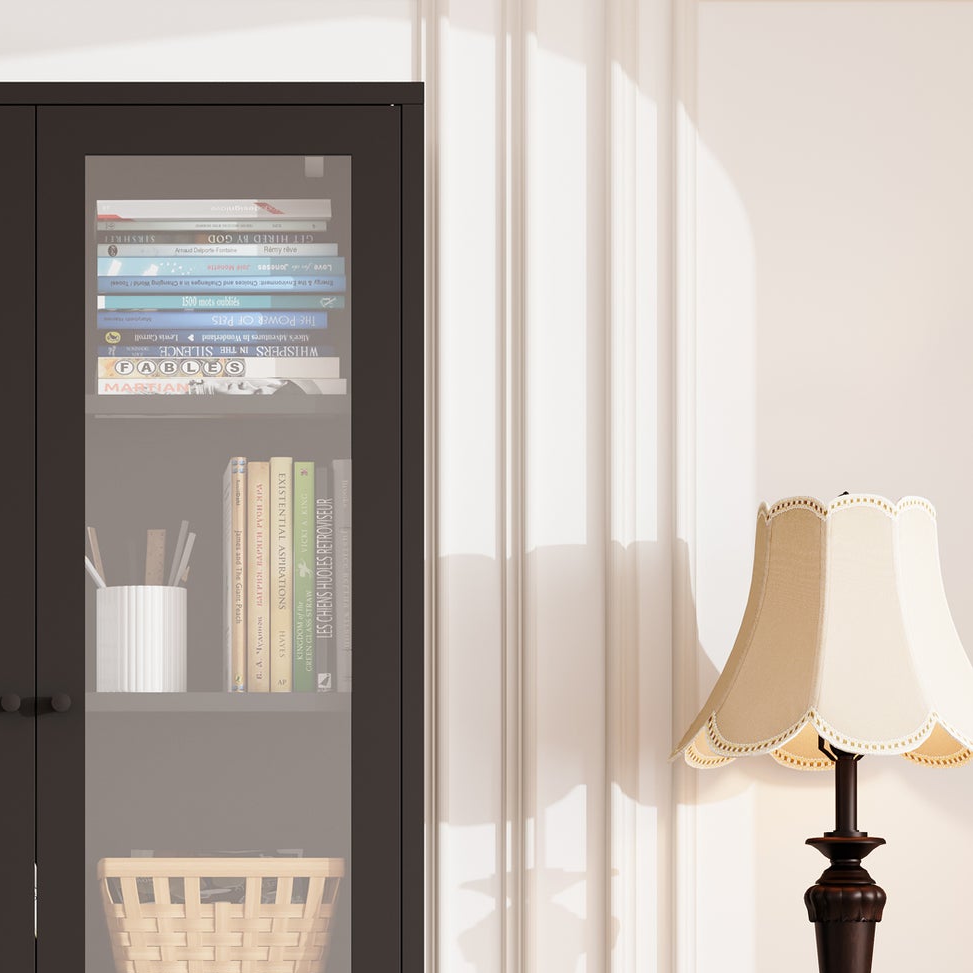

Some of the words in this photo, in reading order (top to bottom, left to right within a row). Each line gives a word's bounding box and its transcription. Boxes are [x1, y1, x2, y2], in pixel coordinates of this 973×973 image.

[208, 234, 233, 243] GOD
[237, 234, 249, 243] BY
[253, 234, 288, 243] HIRED
[293, 234, 314, 243] GET
[151, 279, 178, 287] Changing
[191, 279, 222, 287] Challenges
[313, 279, 334, 287] Energy
[182, 296, 197, 307] 1500
[199, 297, 215, 307] mots
[216, 296, 240, 306] oubliés
[159, 345, 213, 357] SILENCE
[220, 346, 237, 354] THE
[240, 346, 249, 354] IN
[256, 346, 319, 357] WHISPERS
[117, 362, 243, 374] FABLES
[104, 383, 189, 392] MARTIAN
[278, 473, 286, 542] EXISTENTIAL
[300, 493, 308, 515] KING
[317, 498, 333, 554] RETROVISEUR
[234, 530, 243, 551] James
[300, 528, 308, 553] VICKI
[234, 553, 243, 565] and
[234, 567, 243, 581] The
[278, 545, 286, 610] ASPIRATIONS
[234, 582, 243, 601] Giant
[296, 601, 304, 613] the
[305, 590, 313, 617] STRAW
[317, 592, 333, 623] CHIENS
[234, 602, 243, 624] Peach
[305, 618, 313, 643] GLASS
[317, 624, 333, 639] LES
[278, 630, 286, 658] HAYES
[296, 621, 304, 660] KINGDOM
[305, 644, 313, 672] GREEN
